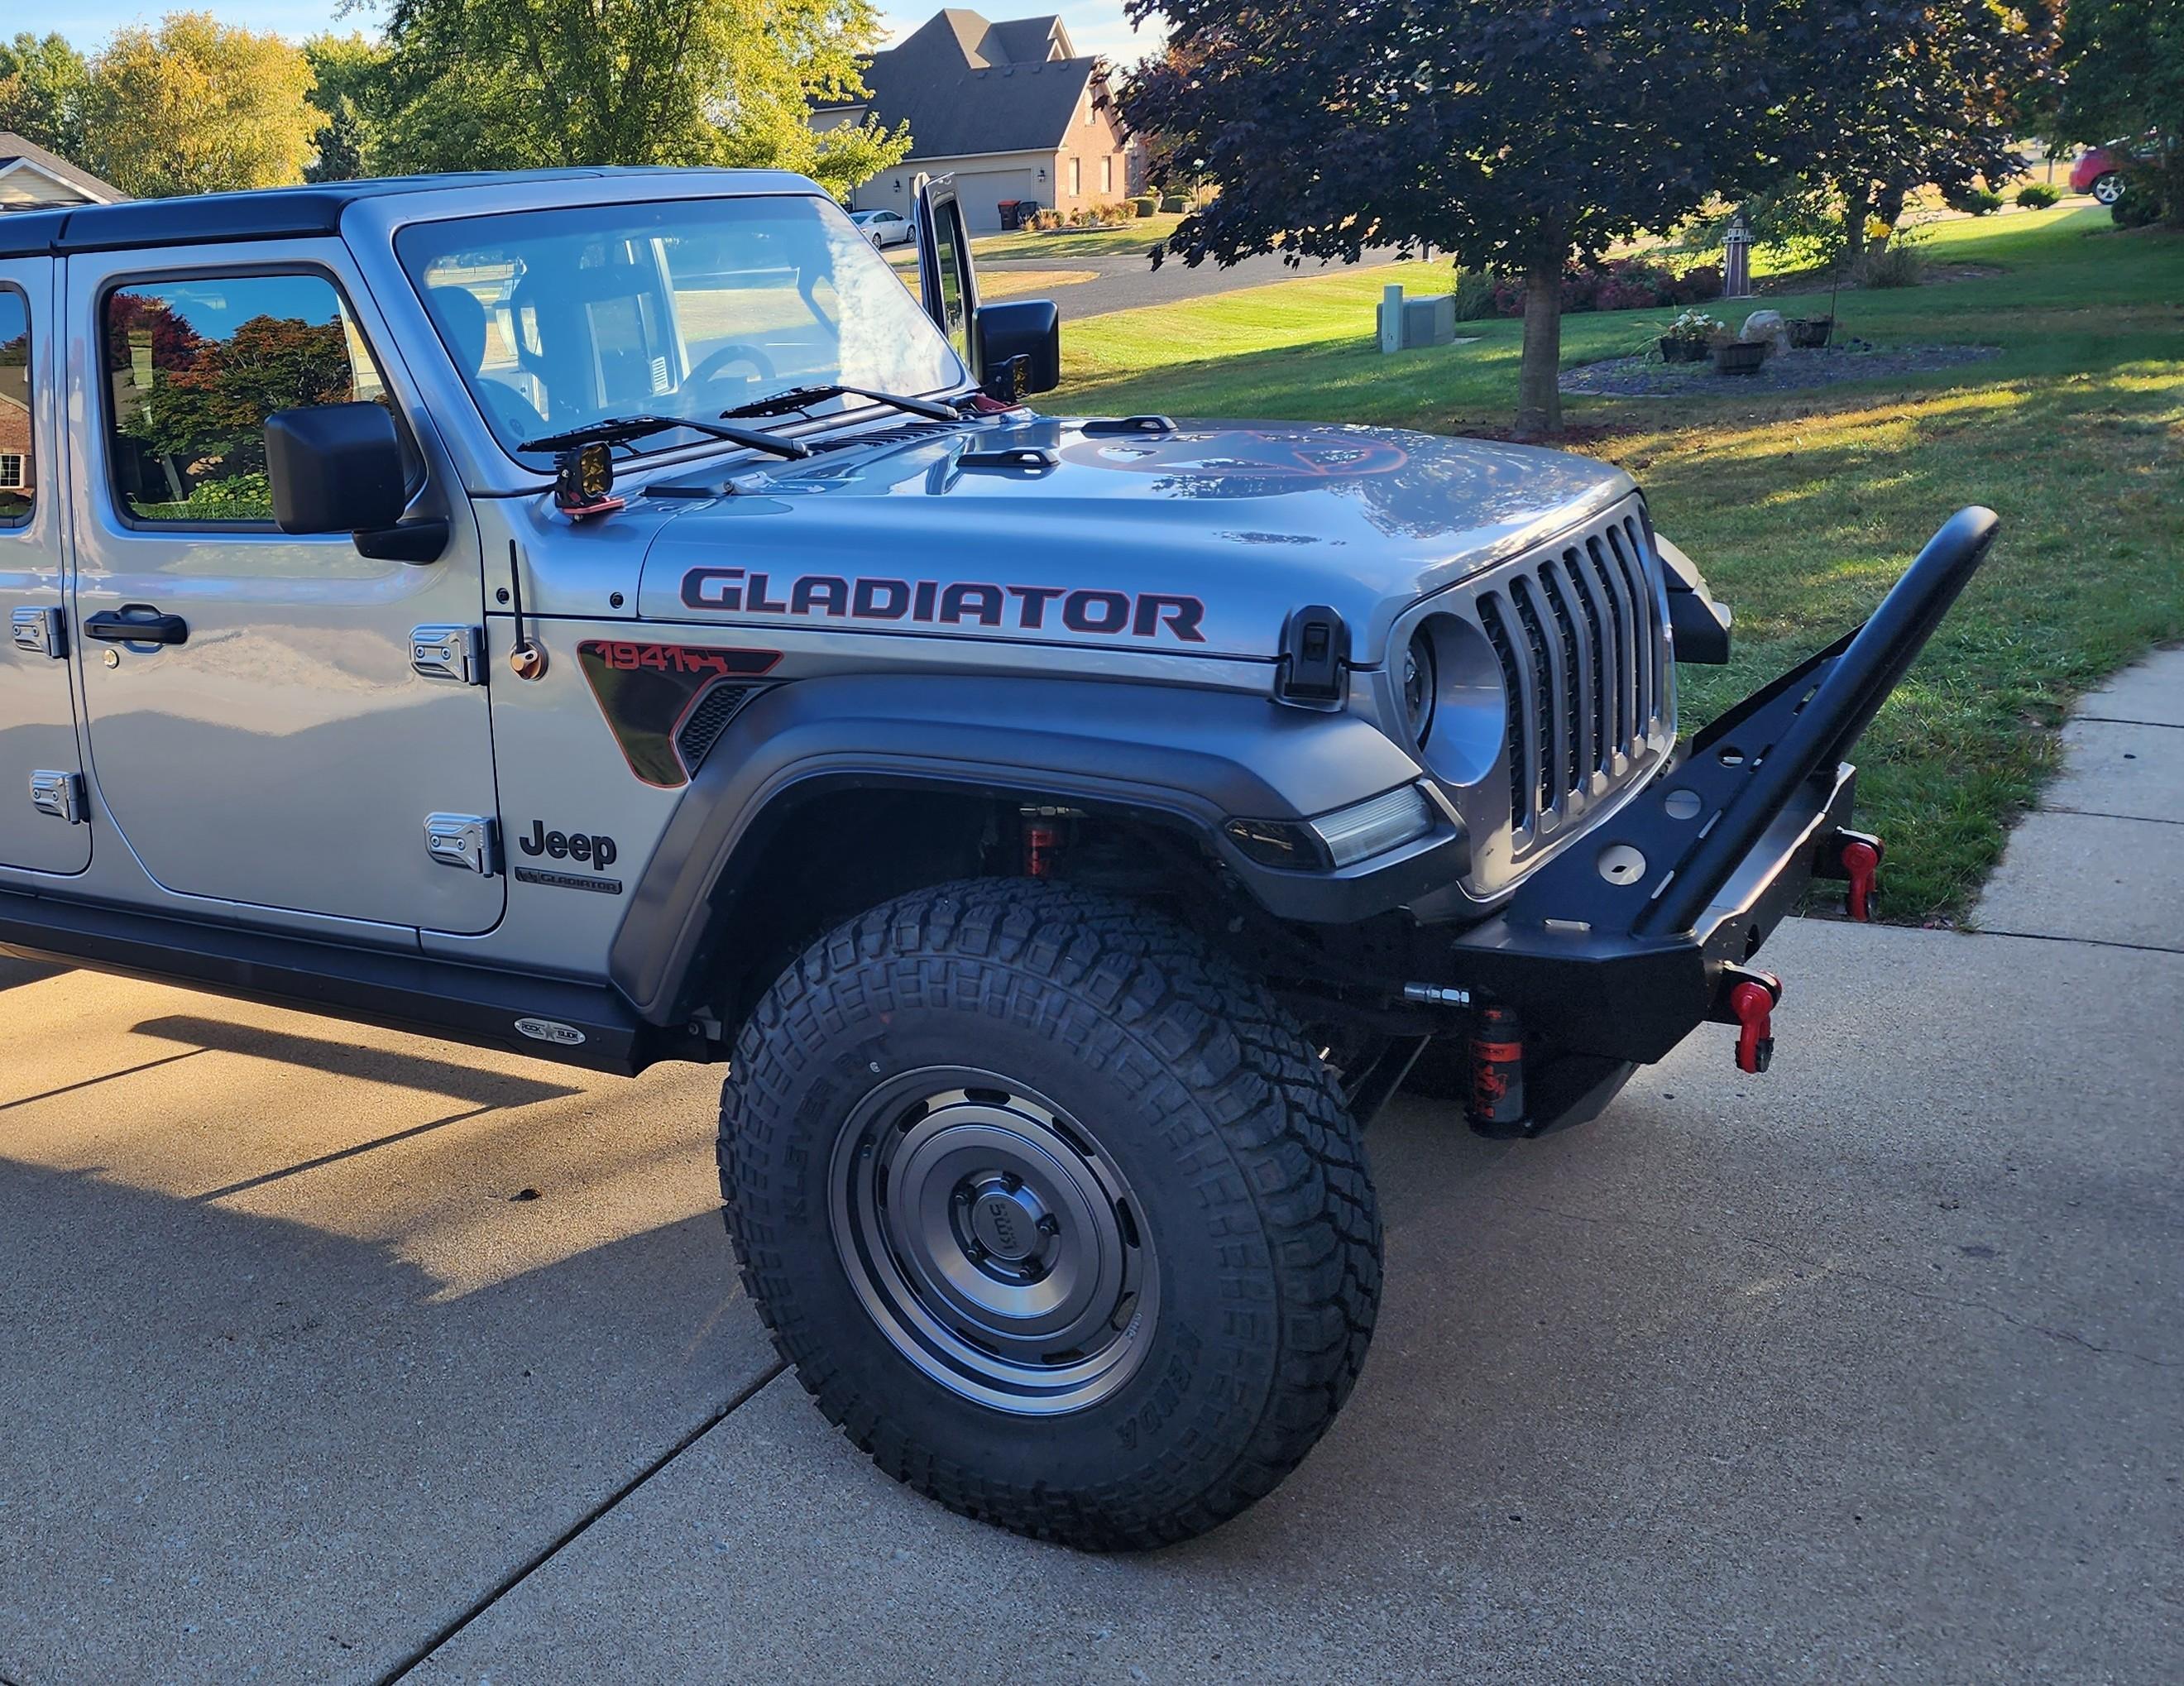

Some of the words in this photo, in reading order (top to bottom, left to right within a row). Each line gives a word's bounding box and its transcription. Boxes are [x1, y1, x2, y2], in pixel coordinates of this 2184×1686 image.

[680, 567, 1208, 643] GLADIATOR
[595, 641, 685, 673] 1941
[519, 819, 617, 871] Jeep
[539, 874, 618, 893] GLADIATOR
[1115, 1321, 1205, 1450] KENDA
